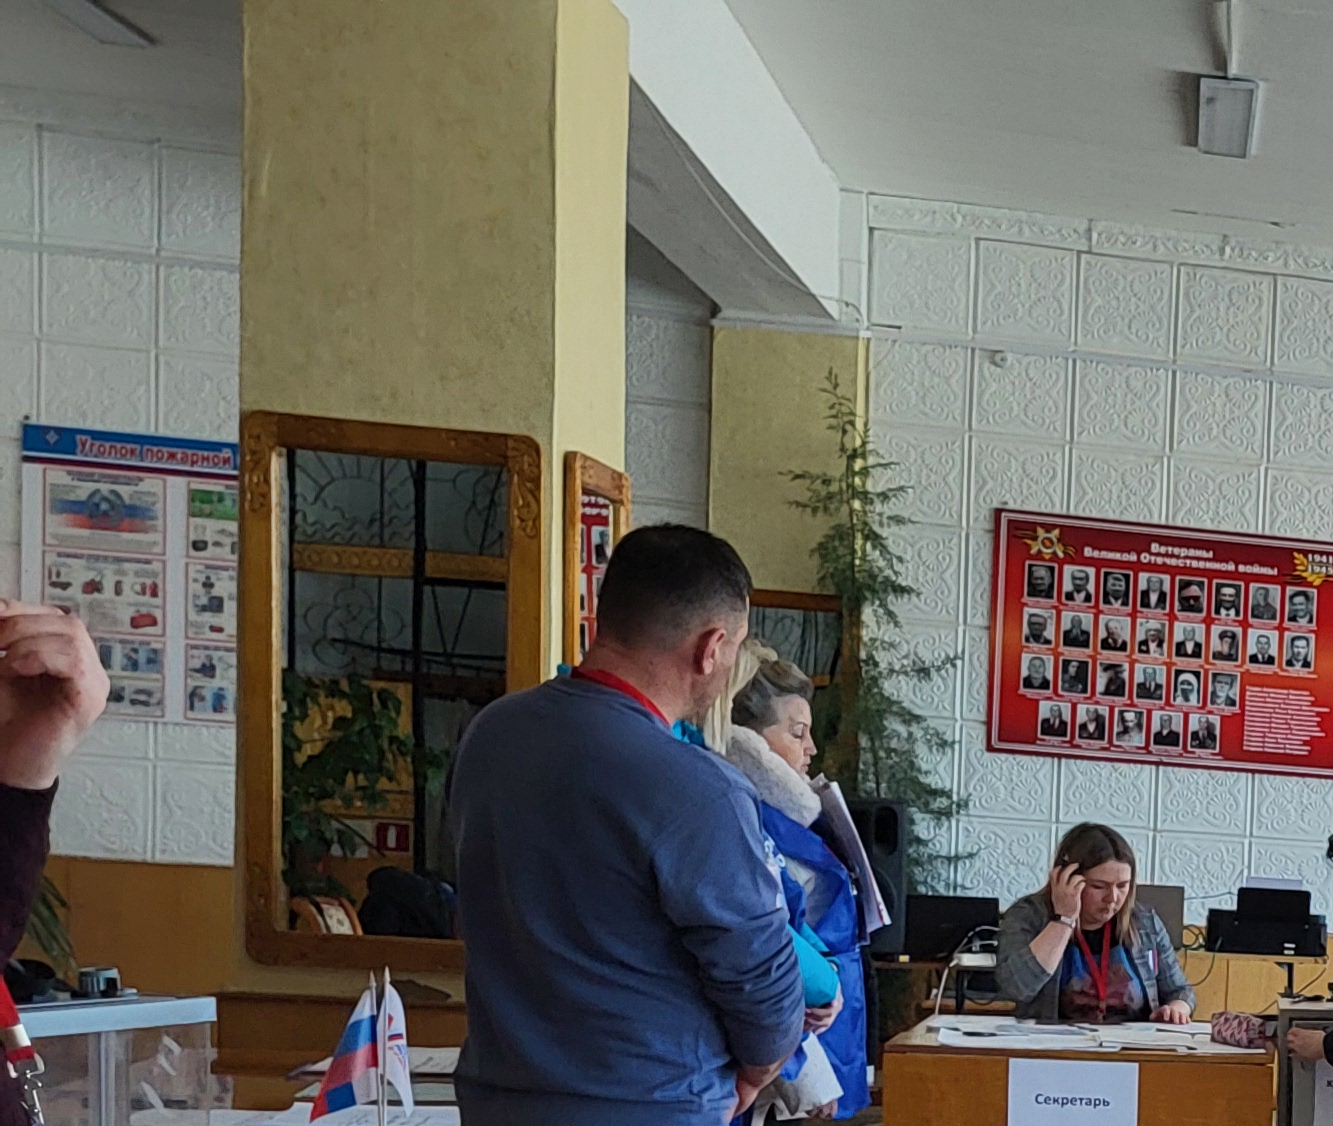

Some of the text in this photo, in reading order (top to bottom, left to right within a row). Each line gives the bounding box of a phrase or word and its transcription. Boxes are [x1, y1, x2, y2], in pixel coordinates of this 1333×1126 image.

[77, 435, 232, 467] Уголок пожарной
[1151, 543, 1213, 559] Ветераны
[1307, 553, 1333, 564] 1941
[1084, 547, 1278, 576] Великой Отечественной войны
[1307, 564, 1333, 575] 1945
[1034, 1093, 1110, 1110] Секретарь
